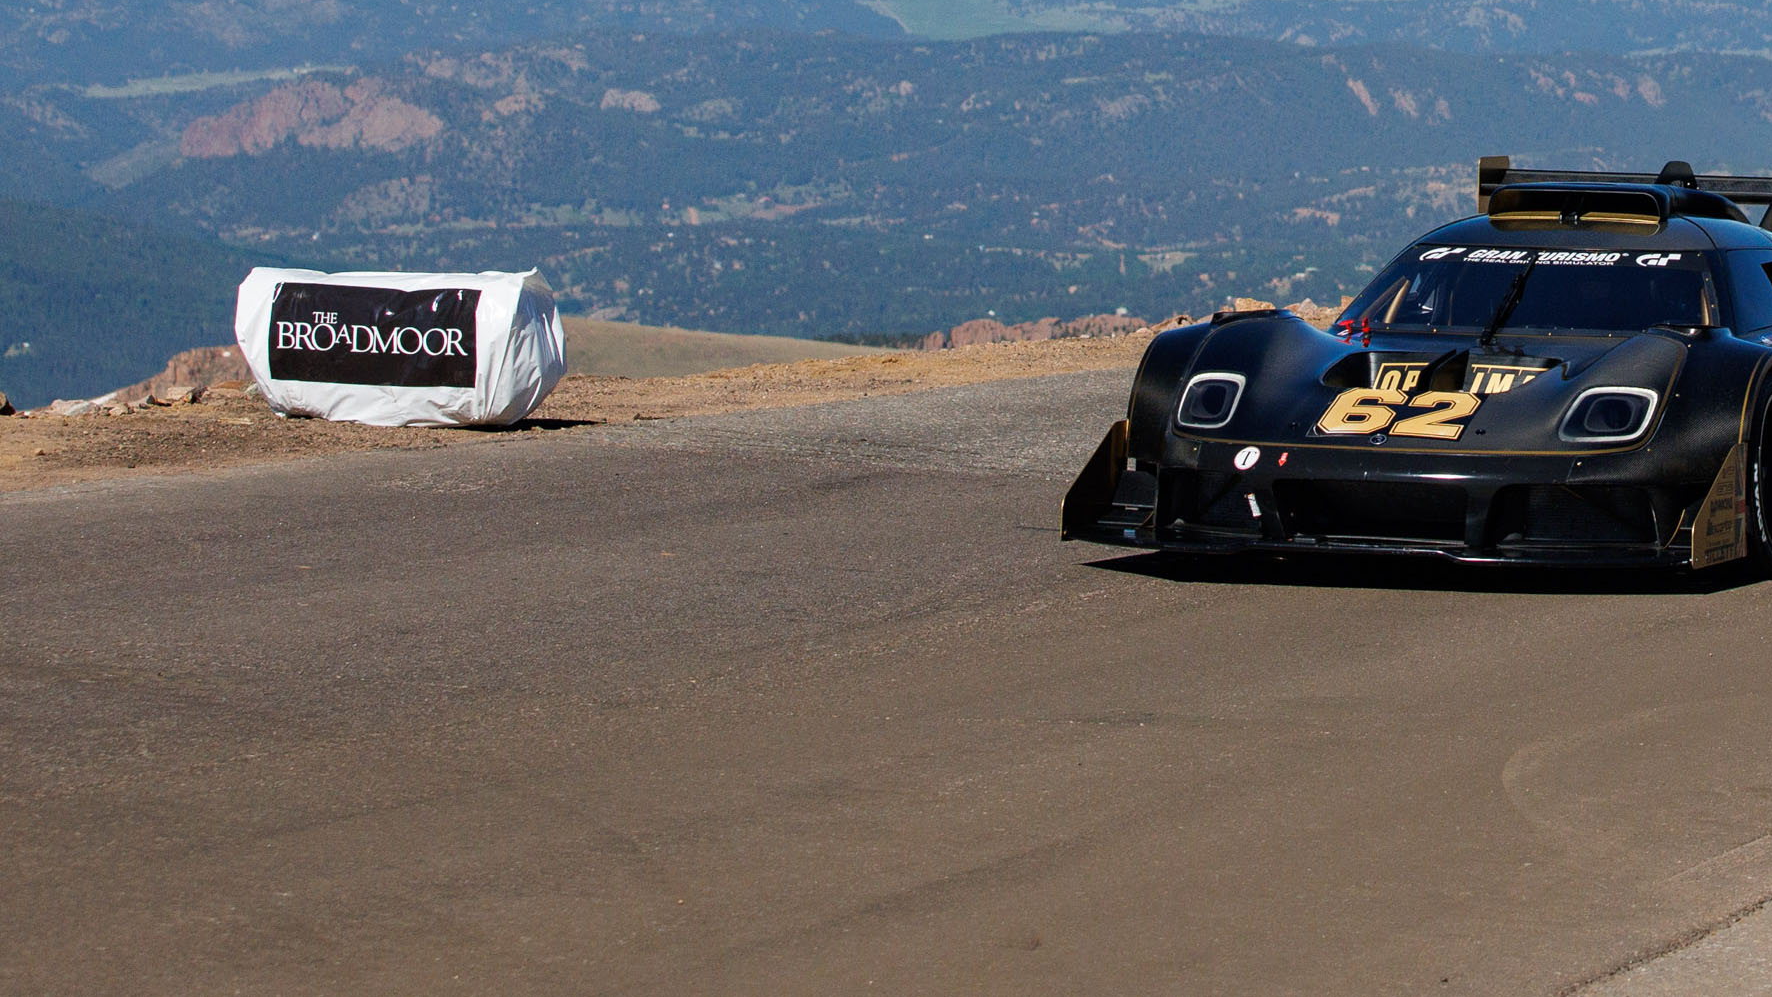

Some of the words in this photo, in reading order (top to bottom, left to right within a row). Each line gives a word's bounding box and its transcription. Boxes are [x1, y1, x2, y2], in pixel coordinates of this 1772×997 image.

[1468, 249, 1528, 260] GRAN
[312, 311, 337, 325] THE
[276, 321, 468, 357] BROADMOOR
[1317, 387, 1481, 441] 62
